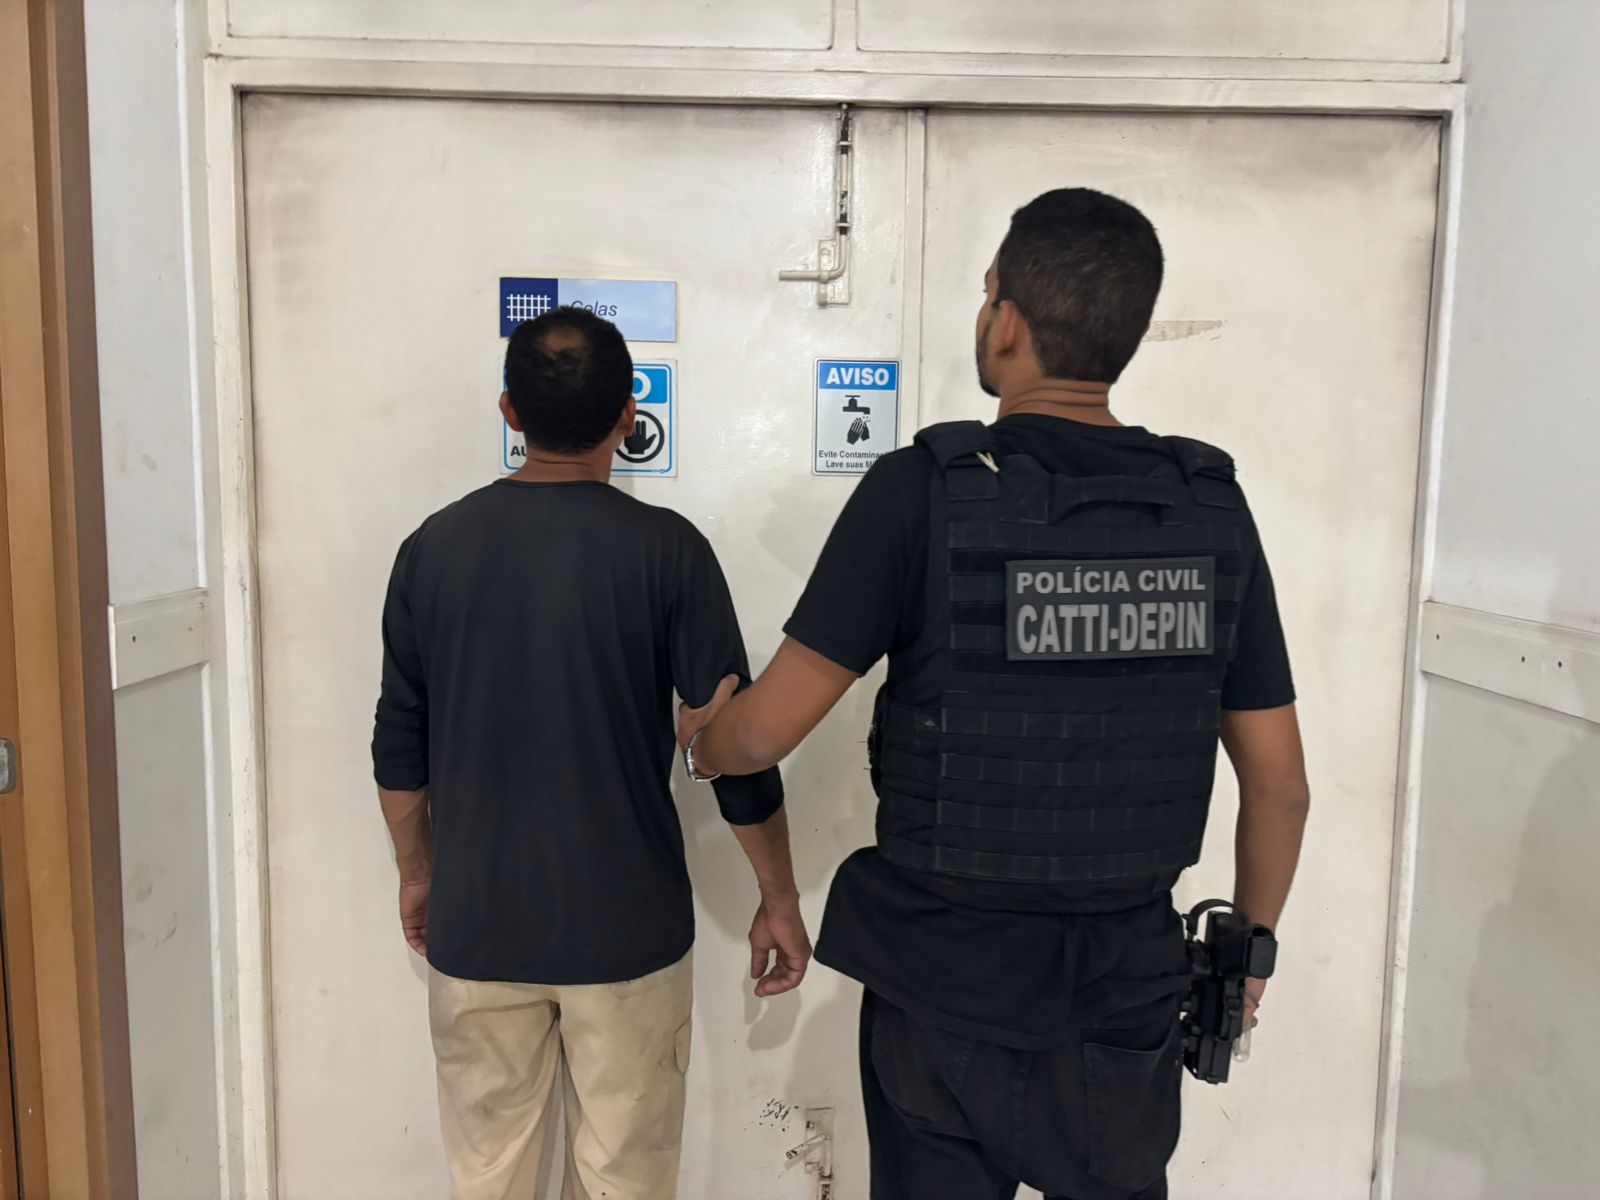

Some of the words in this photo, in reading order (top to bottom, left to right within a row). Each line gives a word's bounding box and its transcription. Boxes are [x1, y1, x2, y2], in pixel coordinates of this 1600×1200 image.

[826, 367, 890, 386] AVISO
[818, 450, 837, 459] Evite
[839, 450, 884, 460] Contamina
[826, 460, 844, 469] Lave
[845, 461, 864, 469] suas
[1016, 566, 1131, 594] POLÍCIA
[1138, 569, 1206, 592] CIVIL
[1016, 601, 1207, 654] CATTI-DEPIN
